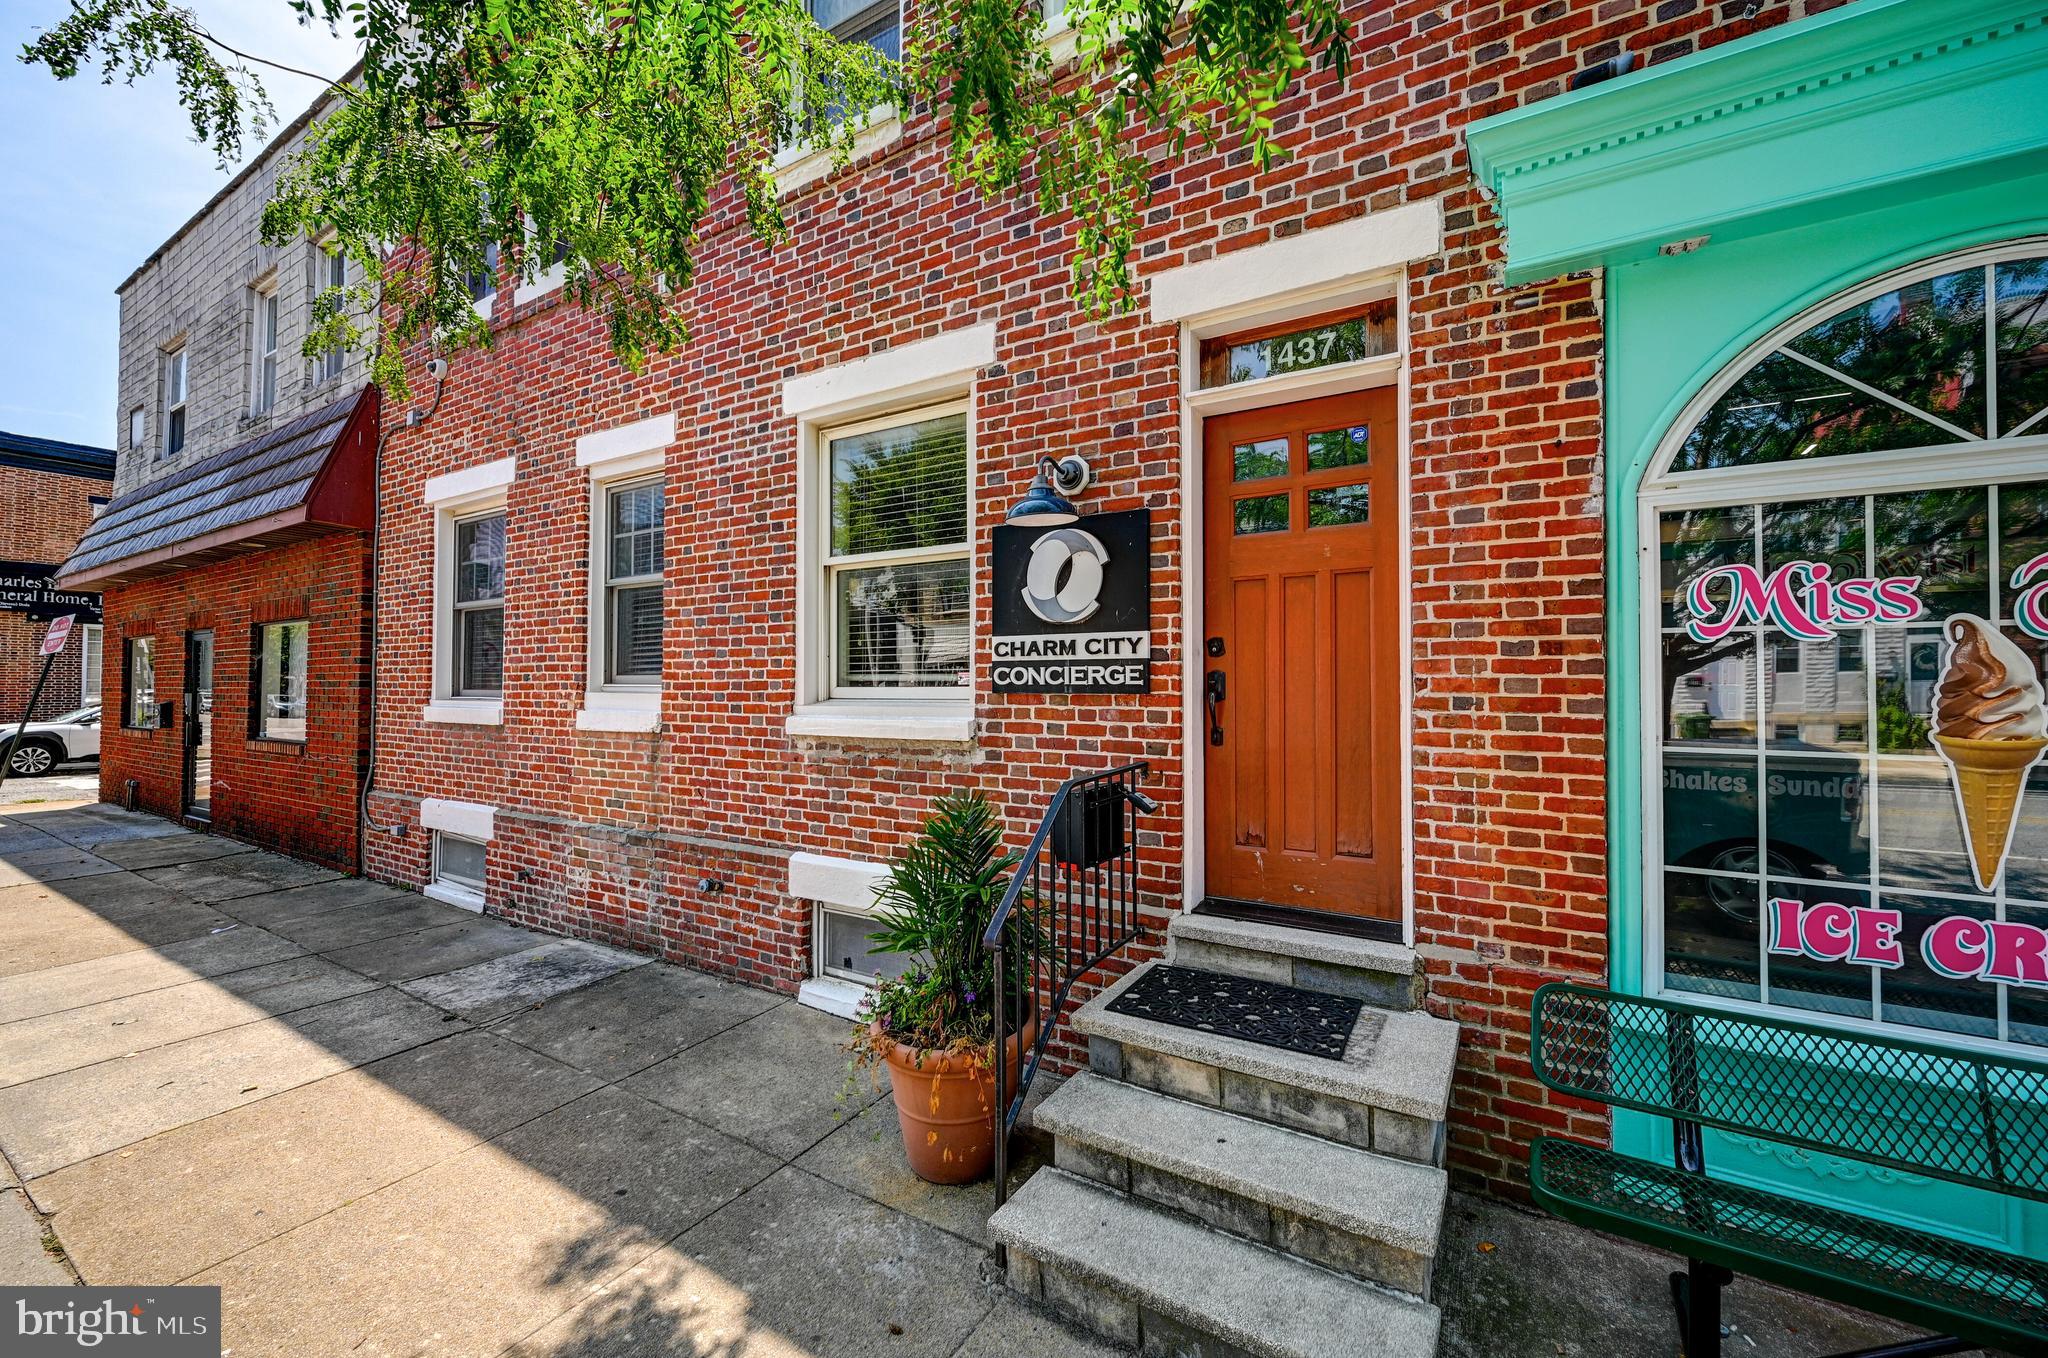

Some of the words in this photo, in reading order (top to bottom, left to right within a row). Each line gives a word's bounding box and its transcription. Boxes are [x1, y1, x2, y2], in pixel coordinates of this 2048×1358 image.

[1259, 331, 1337, 371] 1437
[43, 591, 93, 608] Home,
[1685, 560, 1923, 643] Miss
[993, 639, 1076, 658] CHARM
[1084, 636, 1144, 655] CITY
[993, 664, 1144, 686] CONCIERGE
[1767, 898, 1905, 969] ICE
[1920, 916, 2048, 989] CR
